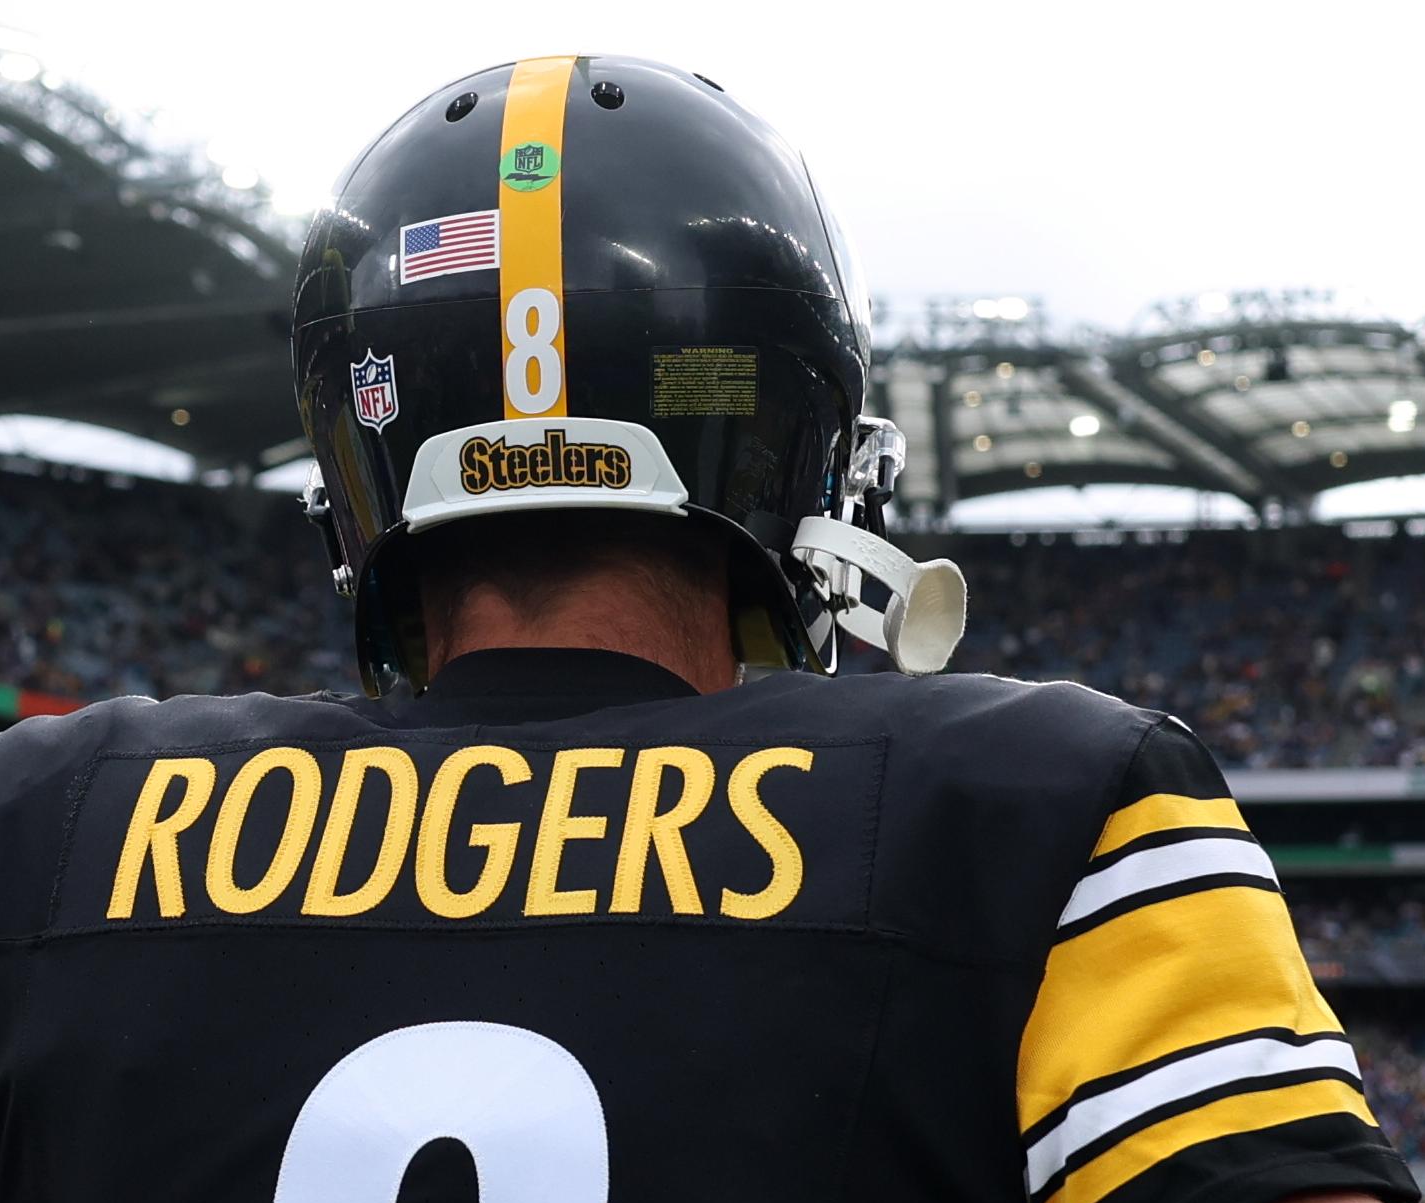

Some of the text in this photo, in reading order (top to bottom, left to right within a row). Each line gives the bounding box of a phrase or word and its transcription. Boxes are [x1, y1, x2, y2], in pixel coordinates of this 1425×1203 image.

[517, 156, 541, 170] NFL
[505, 287, 562, 415] 8
[358, 385, 393, 419] NFL
[459, 429, 631, 494] Steelers
[106, 745, 814, 921] RODGERS
